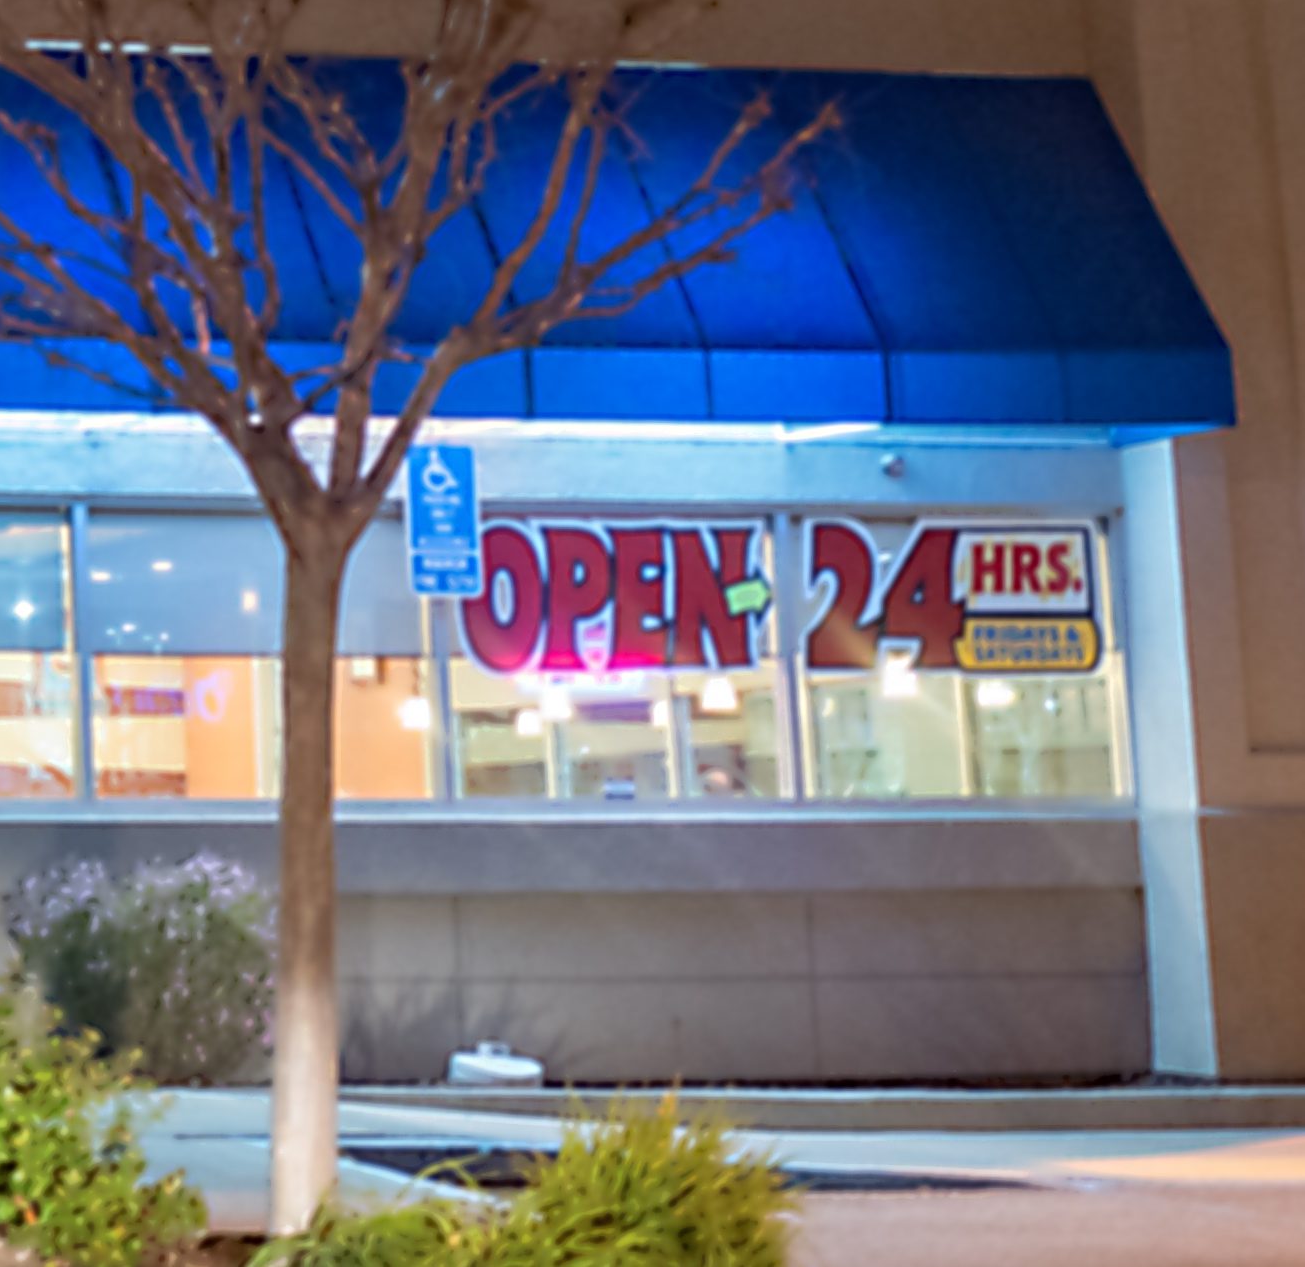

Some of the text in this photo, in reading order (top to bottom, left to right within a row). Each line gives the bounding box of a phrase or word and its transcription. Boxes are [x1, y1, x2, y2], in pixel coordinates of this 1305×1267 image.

[463, 523, 1084, 671] OPEN 24 HRS.
[974, 625, 1059, 642] FRIDAYS
[974, 646, 1084, 661] SATURDAYS
